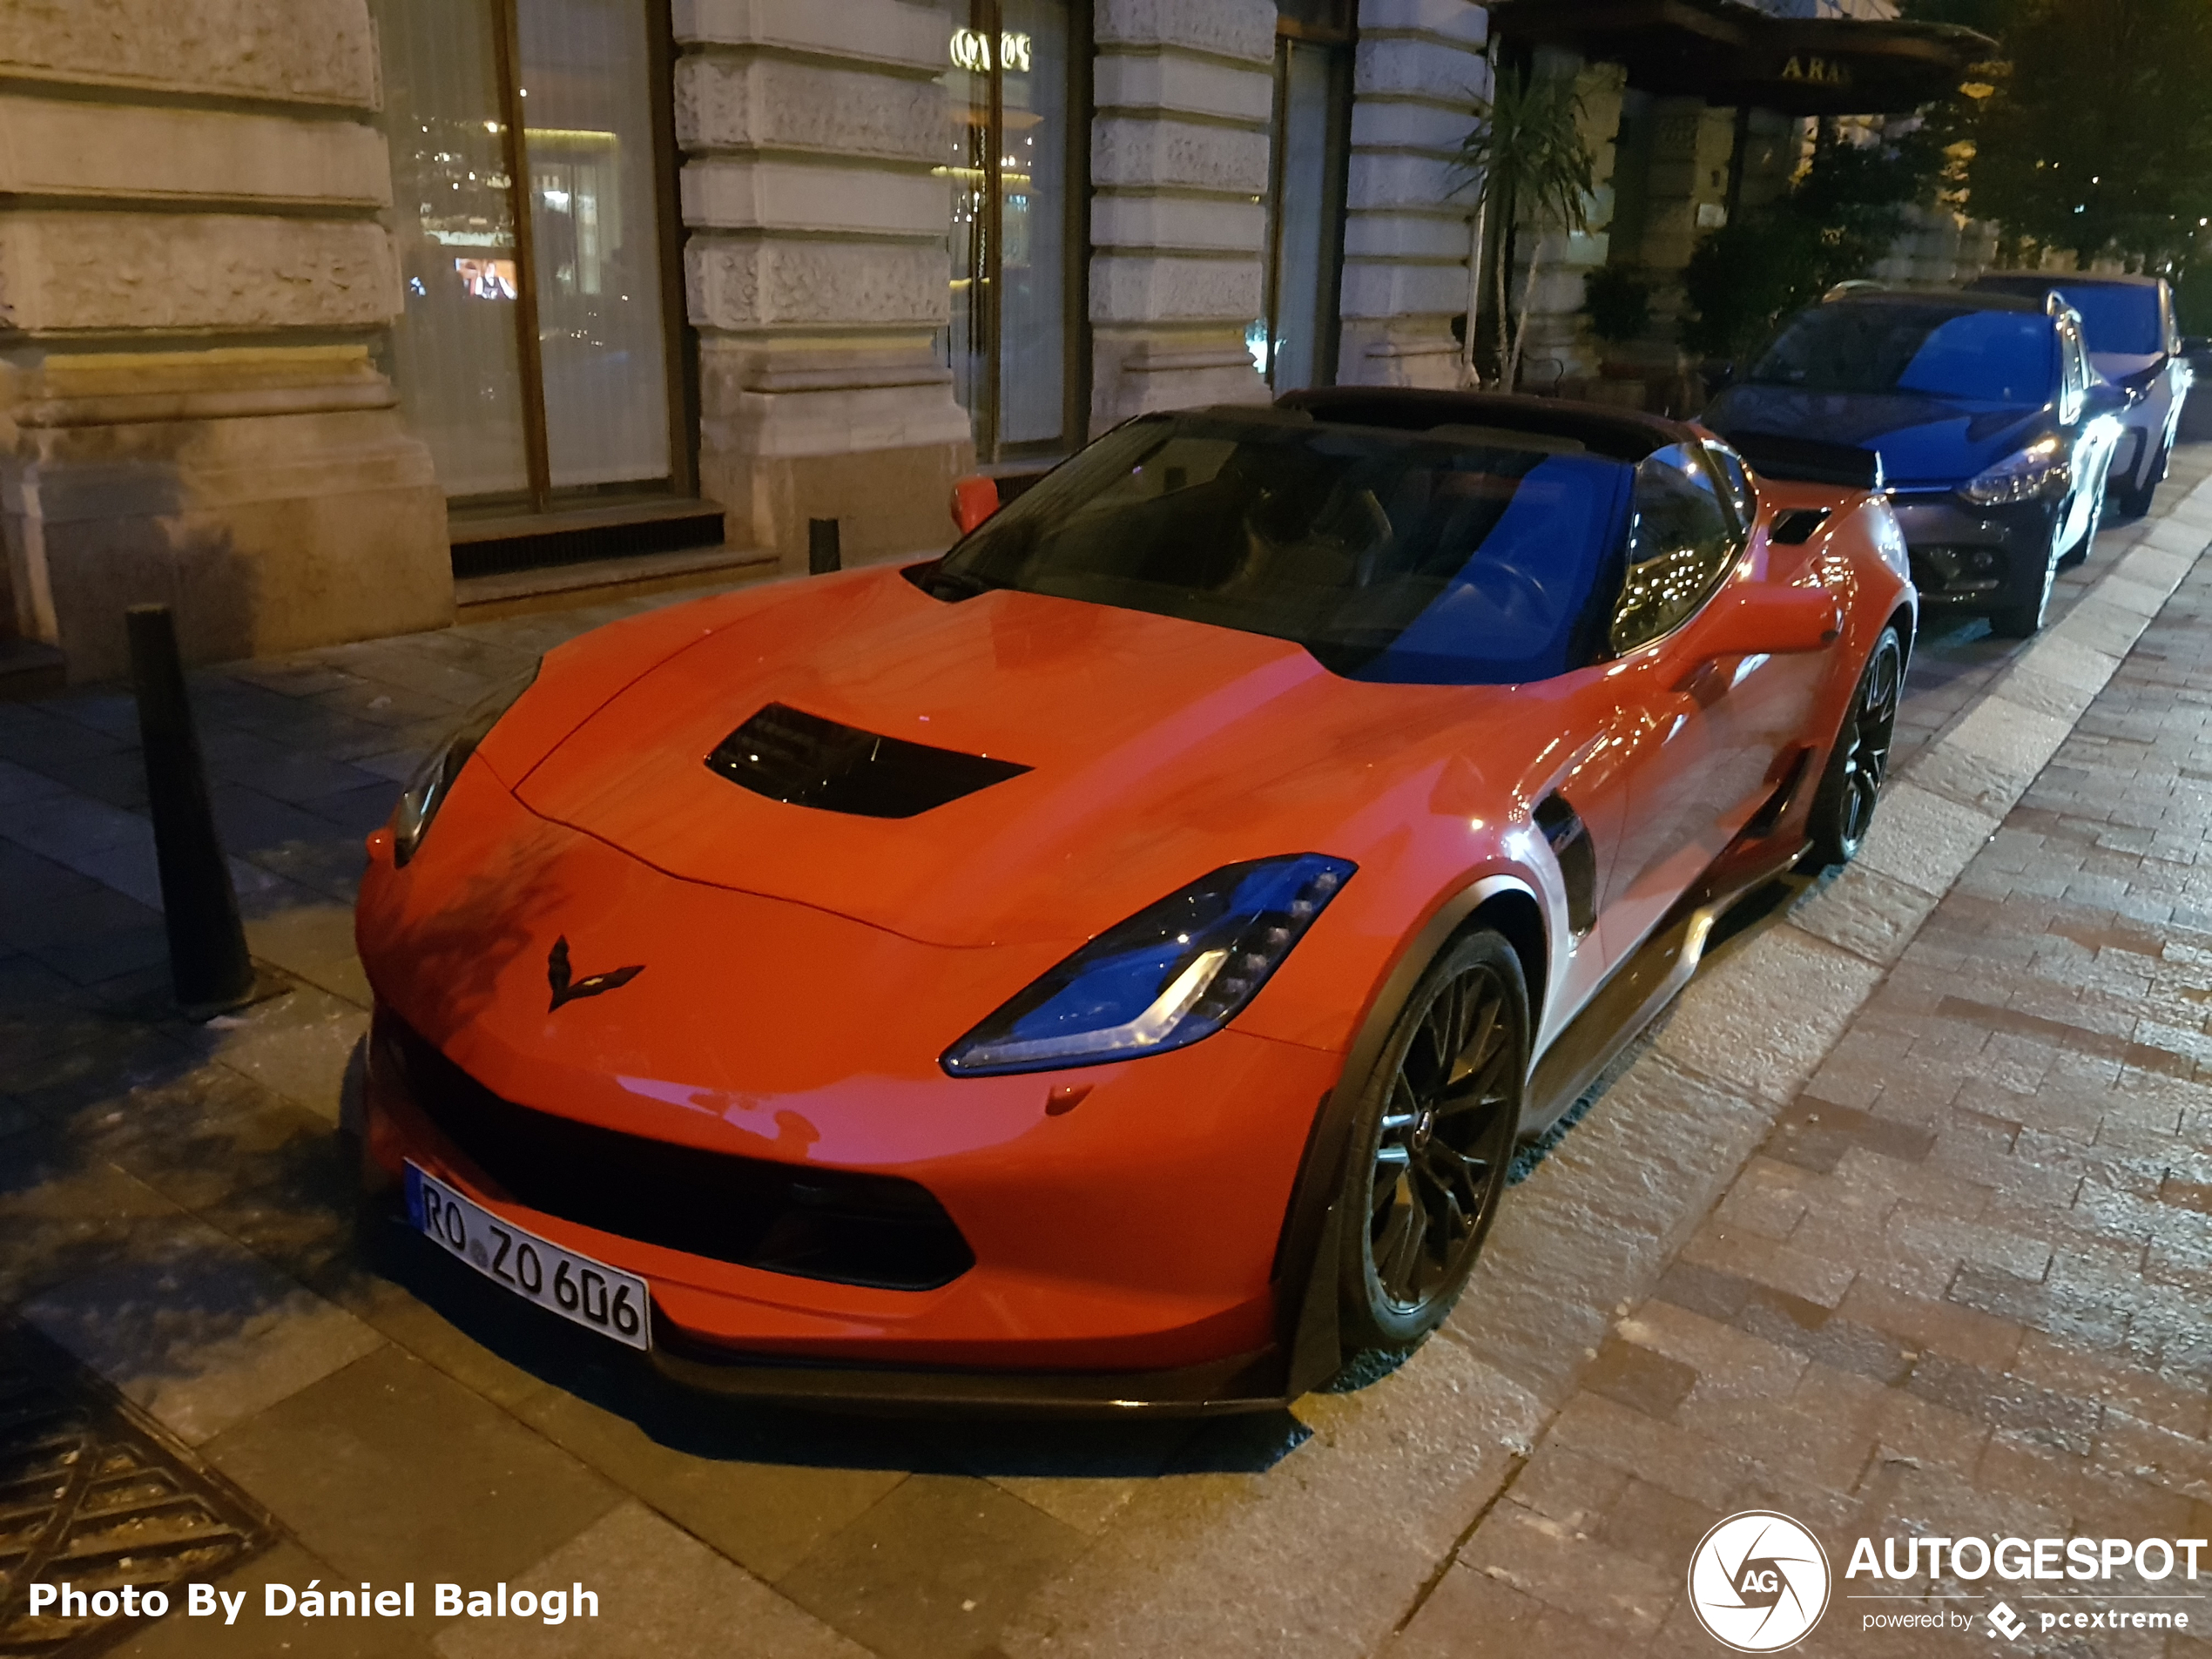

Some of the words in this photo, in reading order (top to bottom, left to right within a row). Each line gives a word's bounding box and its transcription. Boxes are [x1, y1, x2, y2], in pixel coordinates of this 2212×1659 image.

[1781, 55, 1851, 84] ARA
[421, 1182, 467, 1252] RO
[489, 1224, 543, 1296] ZO
[554, 1259, 639, 1337] 606
